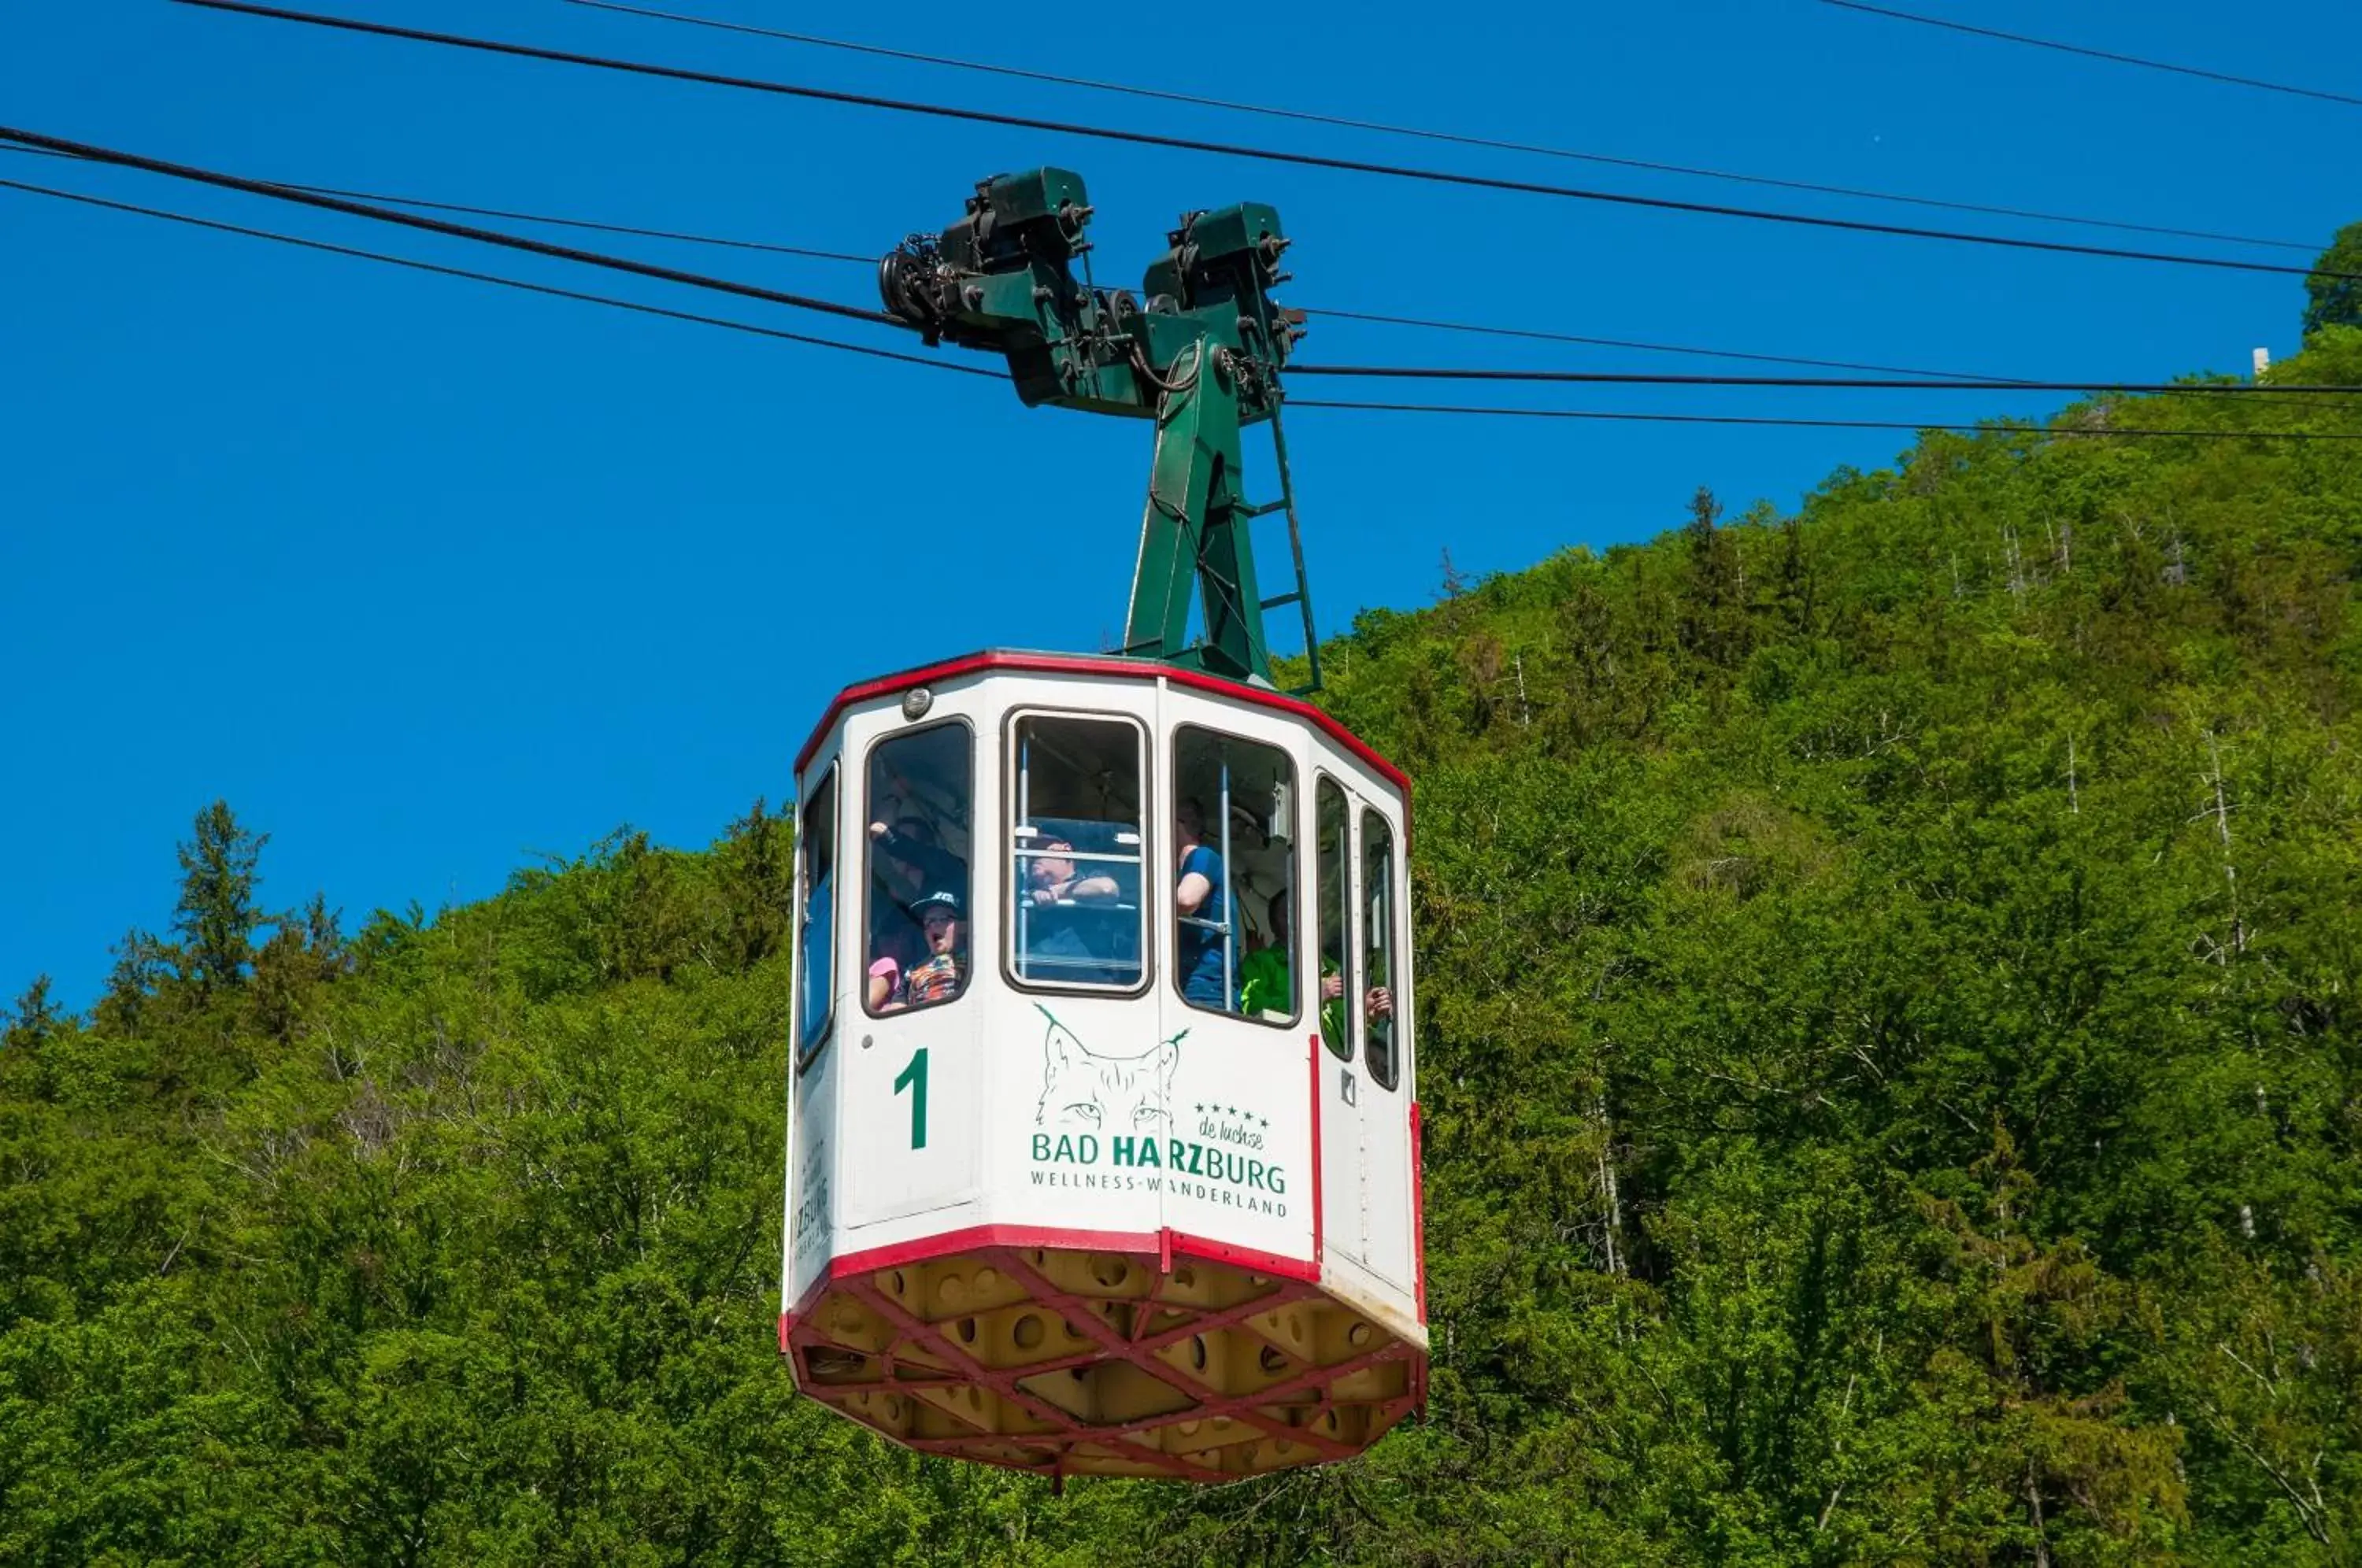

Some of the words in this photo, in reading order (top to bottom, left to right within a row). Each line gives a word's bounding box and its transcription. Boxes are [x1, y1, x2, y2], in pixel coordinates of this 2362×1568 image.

[894, 1047, 928, 1150] 1
[1199, 1115, 1216, 1139] de
[1032, 1133, 1099, 1164] BAD
[1113, 1136, 1286, 1194] HARZBURG
